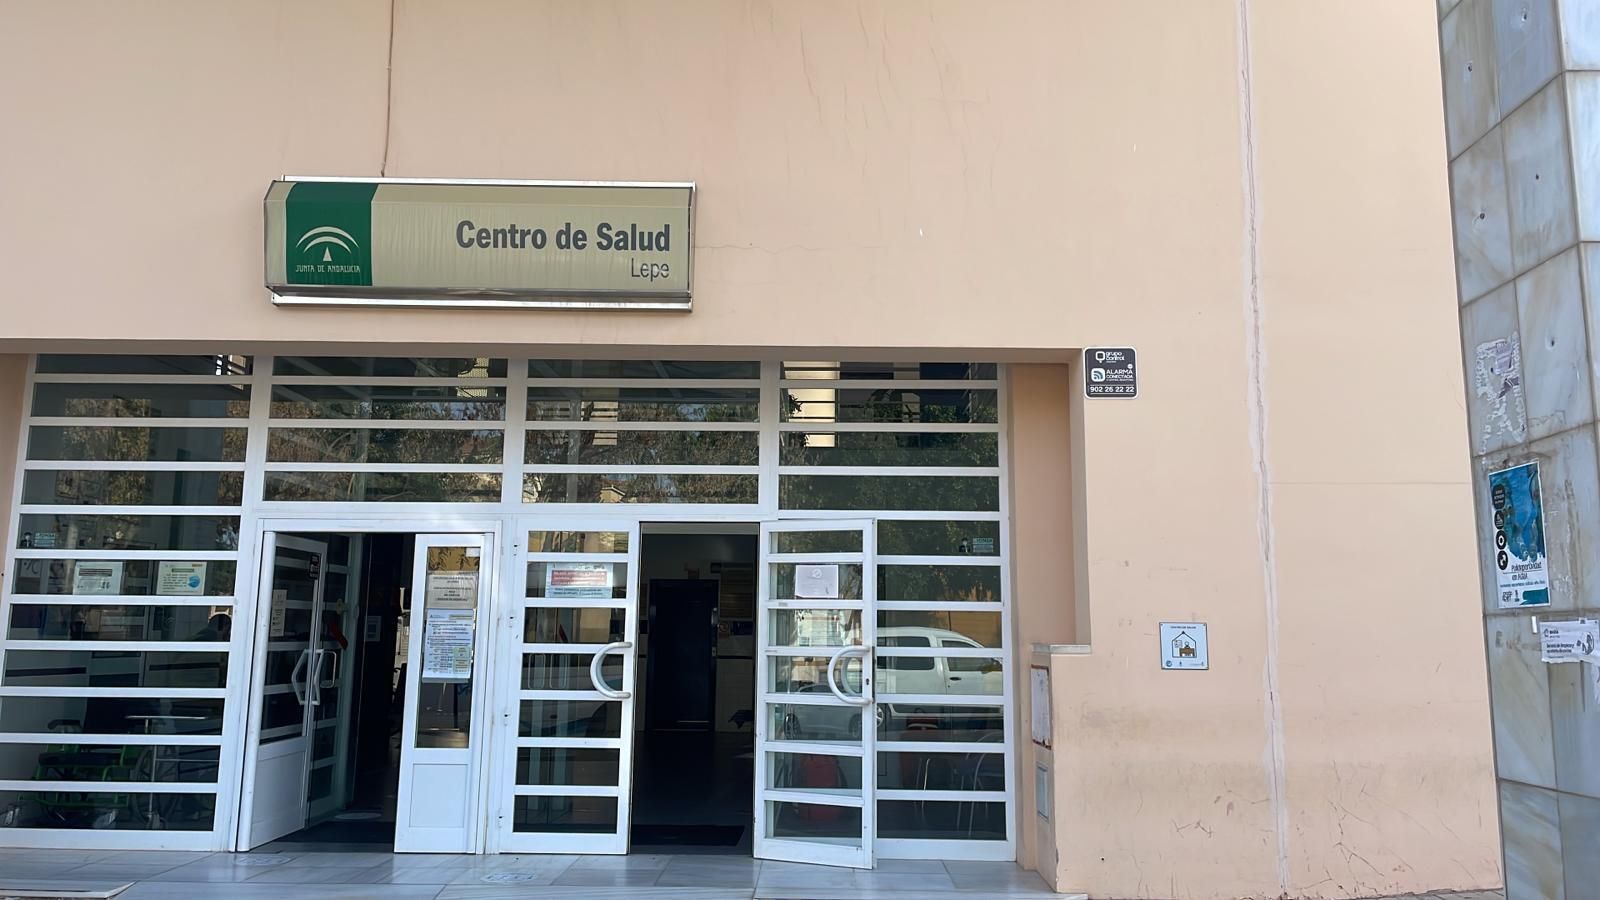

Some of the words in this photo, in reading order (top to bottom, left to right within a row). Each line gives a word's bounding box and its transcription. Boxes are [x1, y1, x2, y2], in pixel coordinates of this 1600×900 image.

[456, 220, 547, 249] Centro
[555, 222, 588, 250] de
[596, 222, 671, 252] Salud
[295, 264, 315, 273] JUNTA
[317, 264, 325, 273] DE
[630, 257, 670, 282] Lepe
